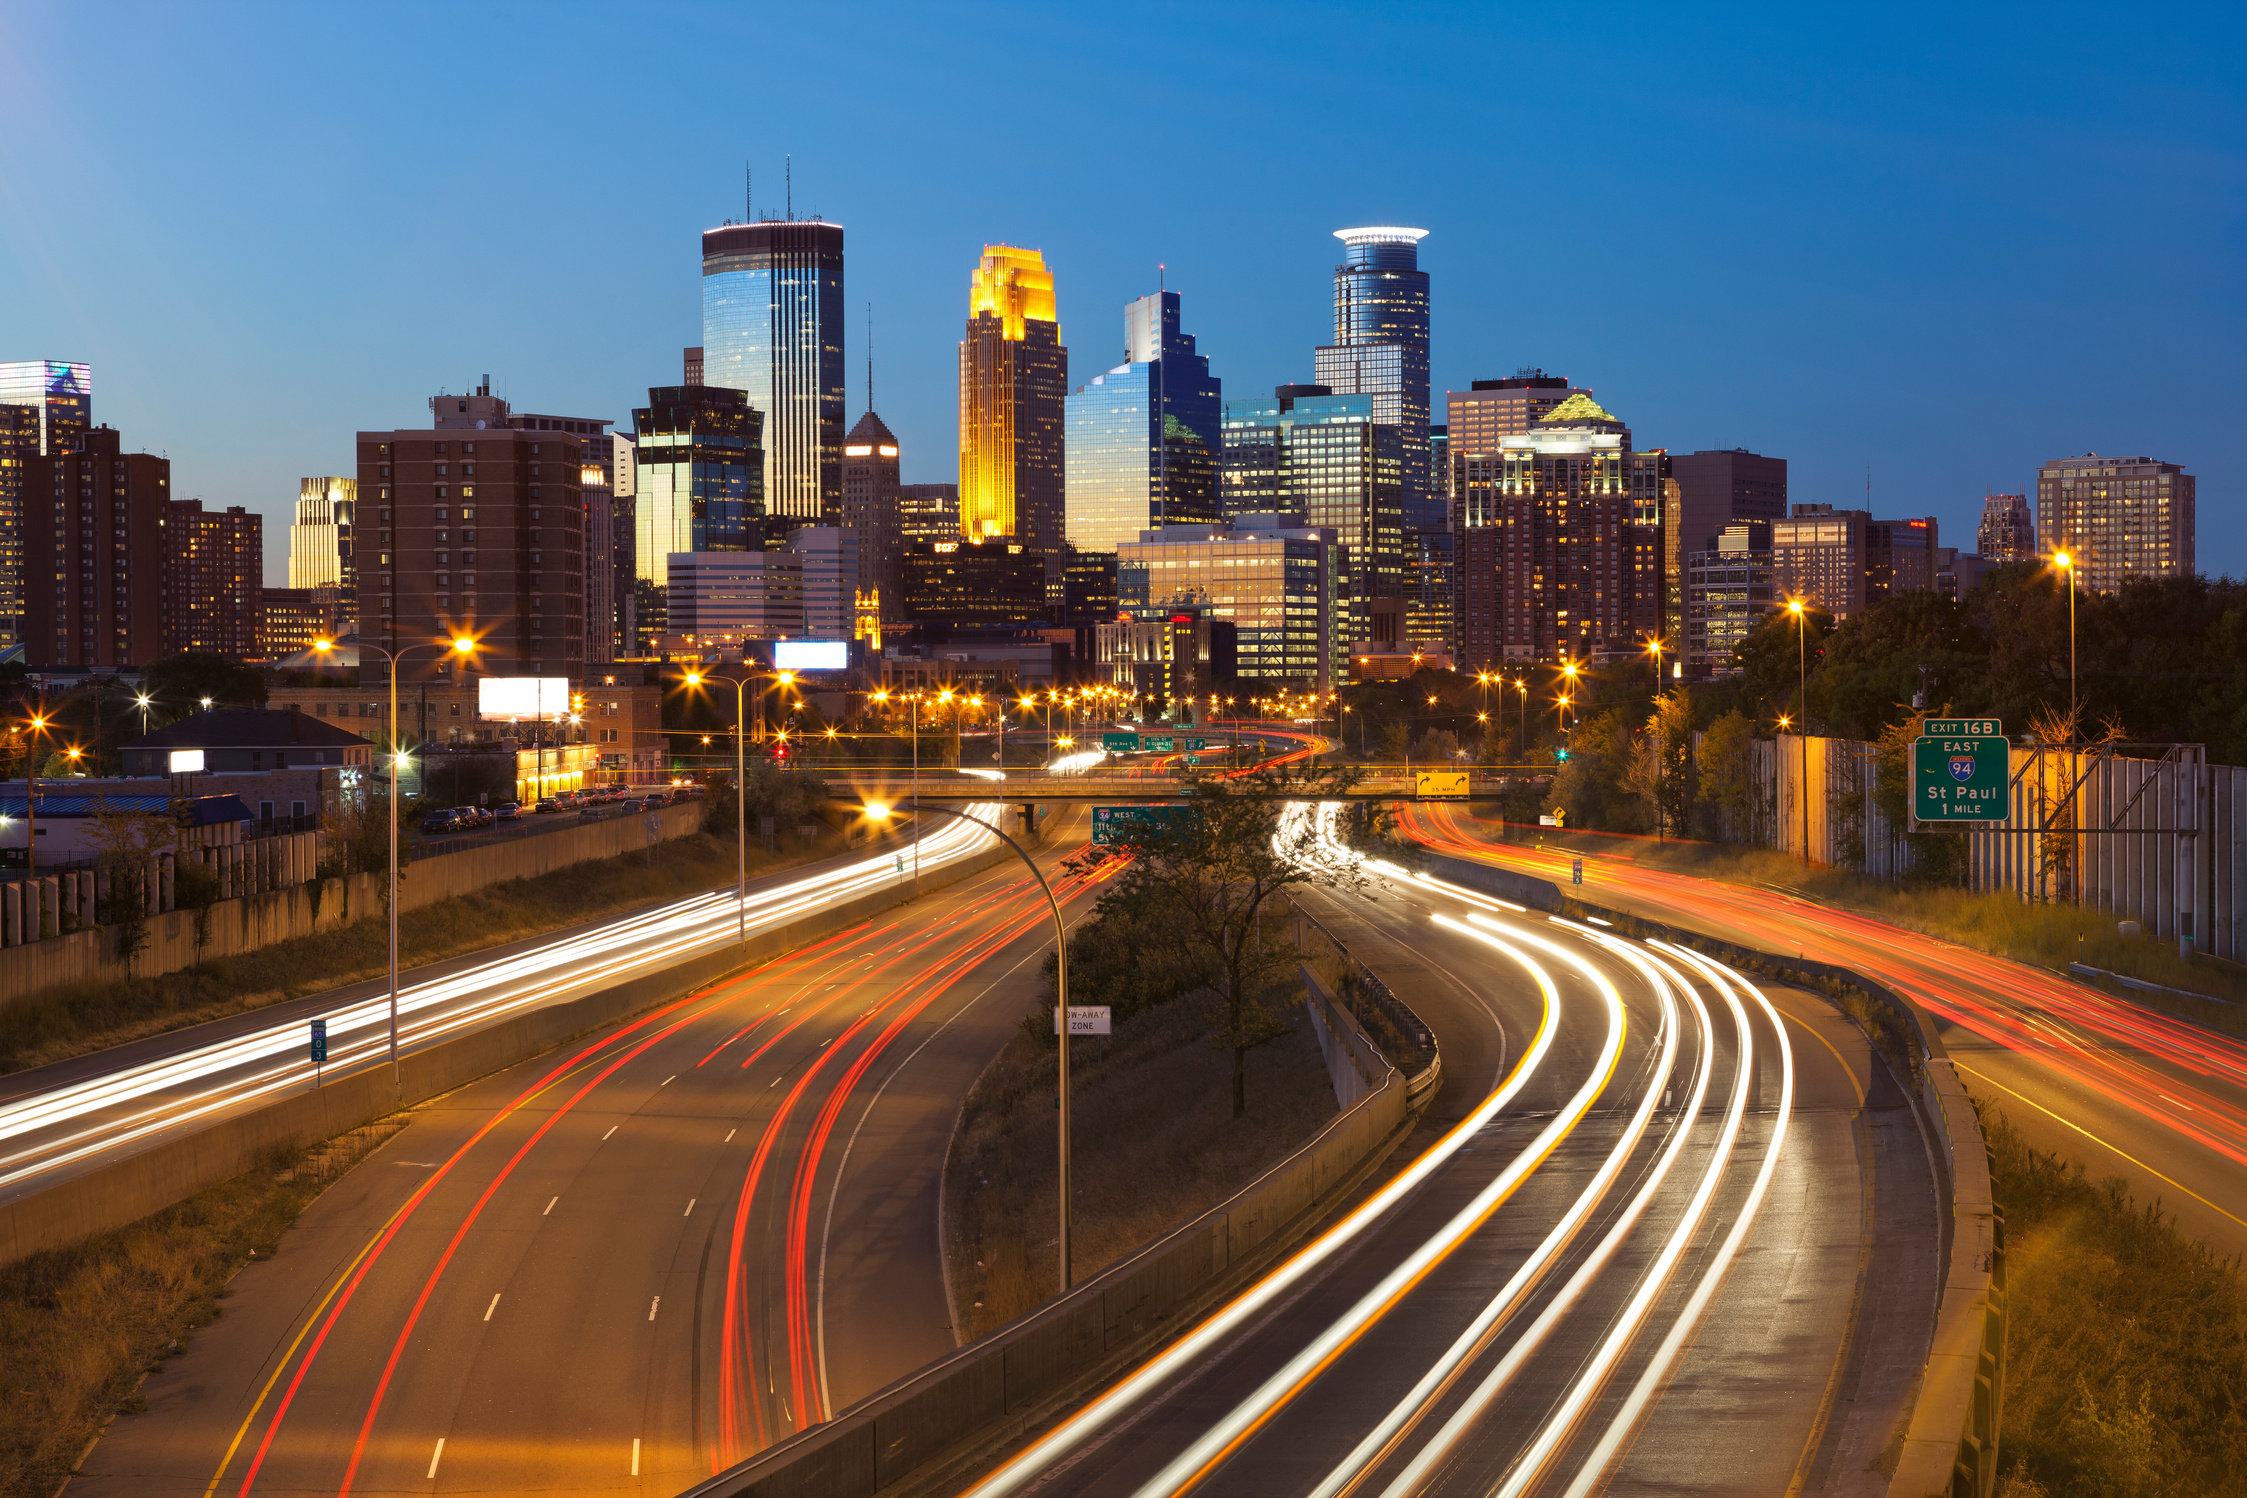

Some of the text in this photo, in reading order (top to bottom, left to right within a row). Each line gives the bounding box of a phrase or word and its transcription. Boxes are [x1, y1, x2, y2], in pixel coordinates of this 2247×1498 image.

[1931, 722, 1993, 734] EXIT 16B
[1943, 741, 1980, 752] EAST
[1952, 763, 1971, 775] 94
[1928, 786, 1996, 799] St Paul
[1942, 803, 1981, 815] 1 MILE
[315, 1040, 322, 1048] 0
